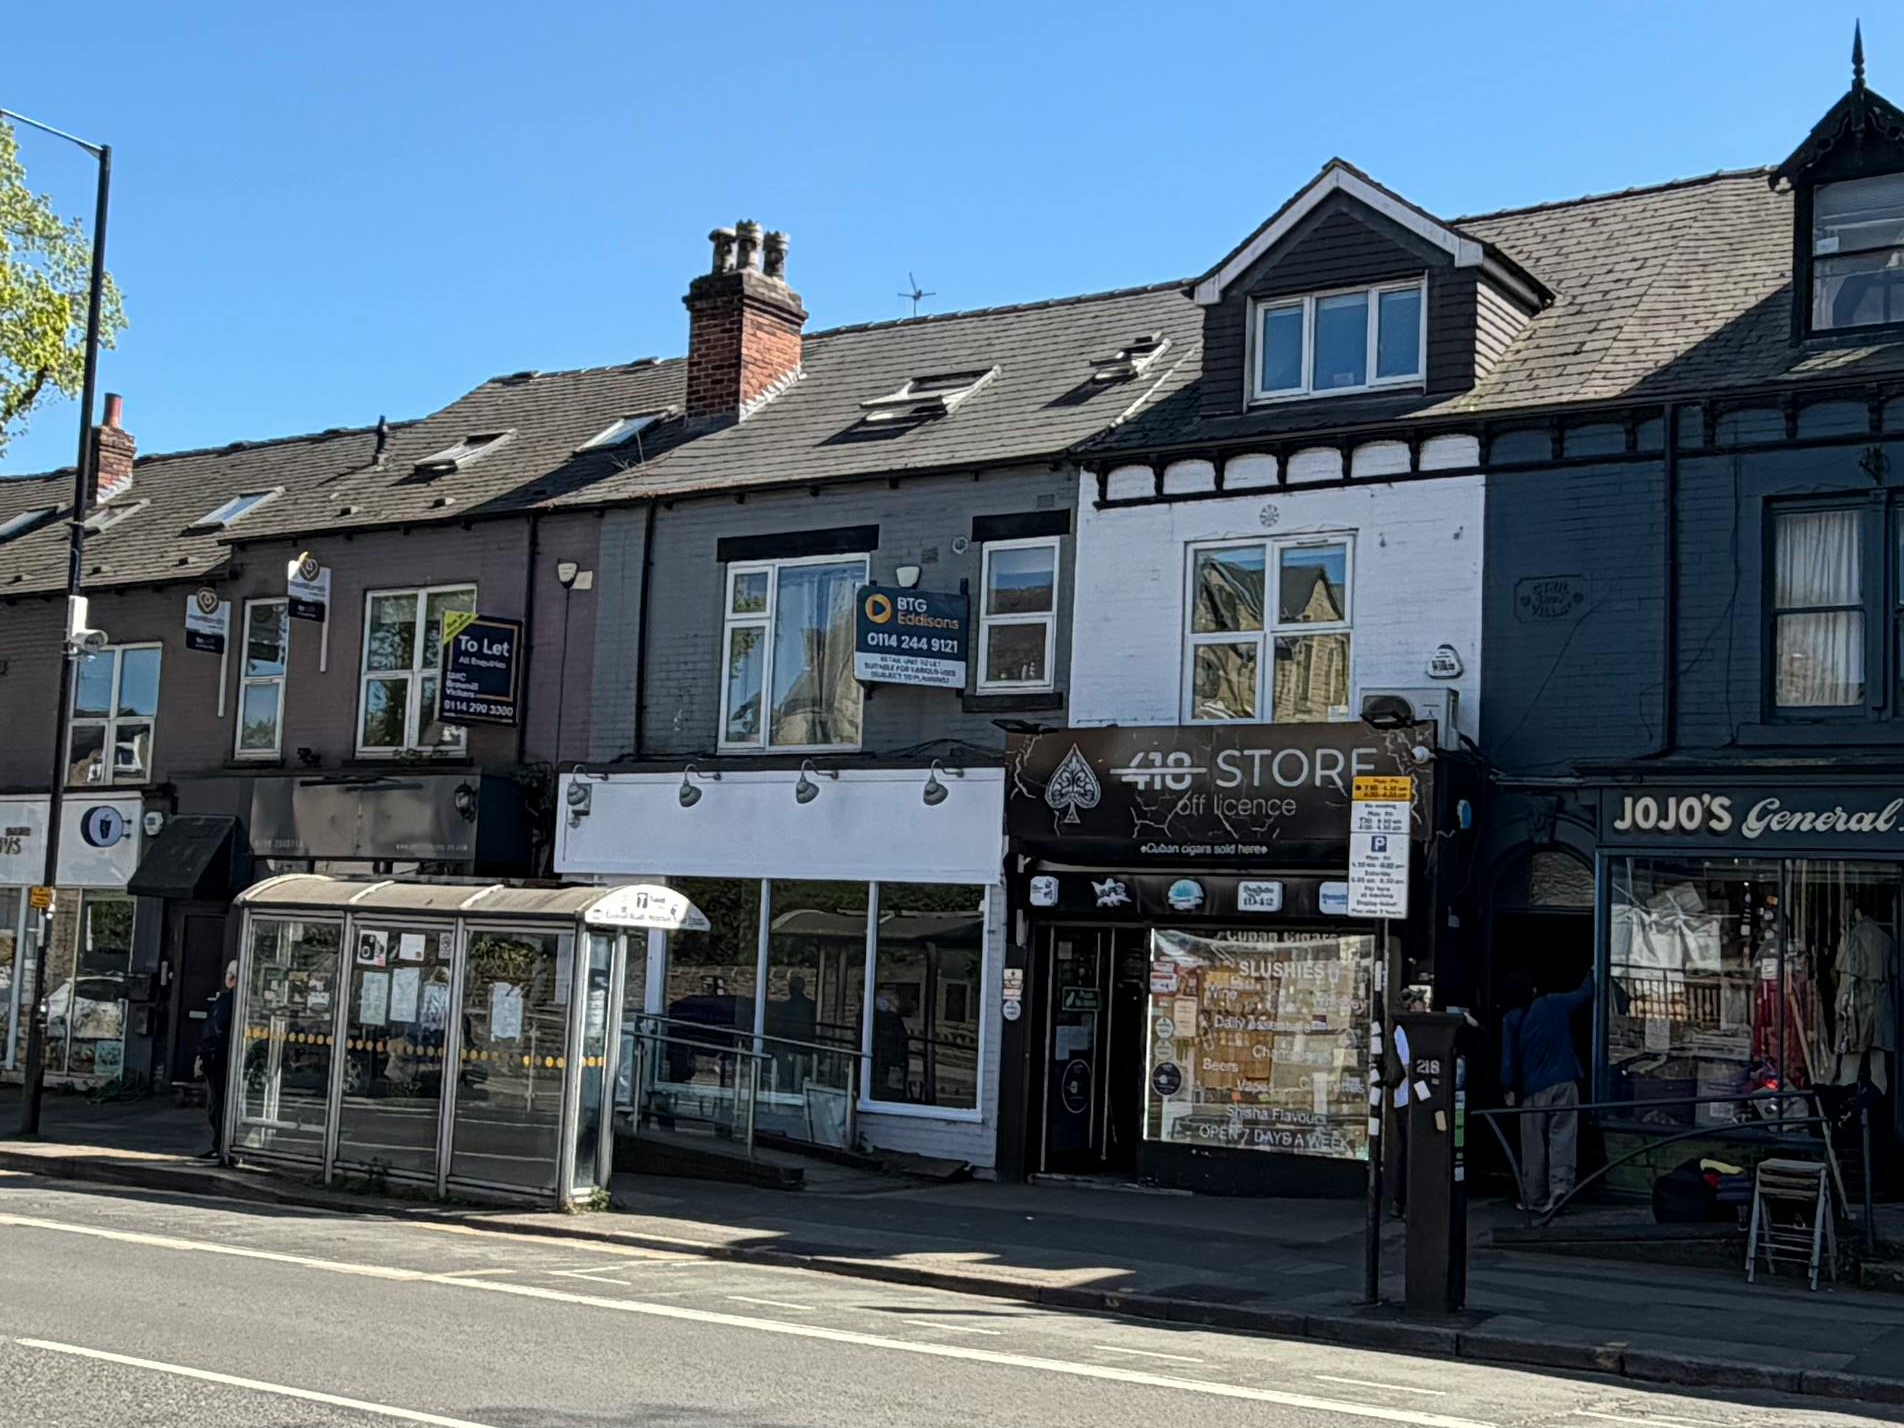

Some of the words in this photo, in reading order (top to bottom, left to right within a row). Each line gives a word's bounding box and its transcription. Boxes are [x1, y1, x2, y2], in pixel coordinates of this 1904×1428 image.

[897, 596, 928, 613] BTG
[897, 612, 960, 629] Eddisons
[458, 635, 478, 653] To
[483, 638, 510, 657] Let
[867, 632, 897, 647] 0114
[901, 636, 928, 650] 244
[931, 638, 958, 653] 9121
[444, 700, 467, 711] 0114
[469, 703, 487, 713] 290
[489, 705, 513, 716] 3300
[1120, 751, 1194, 790] 418
[1176, 793, 1207, 817] off
[1213, 794, 1297, 816] licence
[1613, 793, 1733, 832] JOJO'S
[1741, 797, 1904, 840] General
[1239, 960, 1326, 979] SLUSHIES
[1214, 1014, 1246, 1030] Daily
[1202, 1058, 1240, 1073] Beers
[1199, 1125, 1238, 1141] OPEN
[1241, 1129, 1250, 1143] 7
[1254, 1130, 1293, 1146] DAYS
[1294, 1134, 1304, 1147] A
[1306, 1135, 1351, 1152] WEEK
